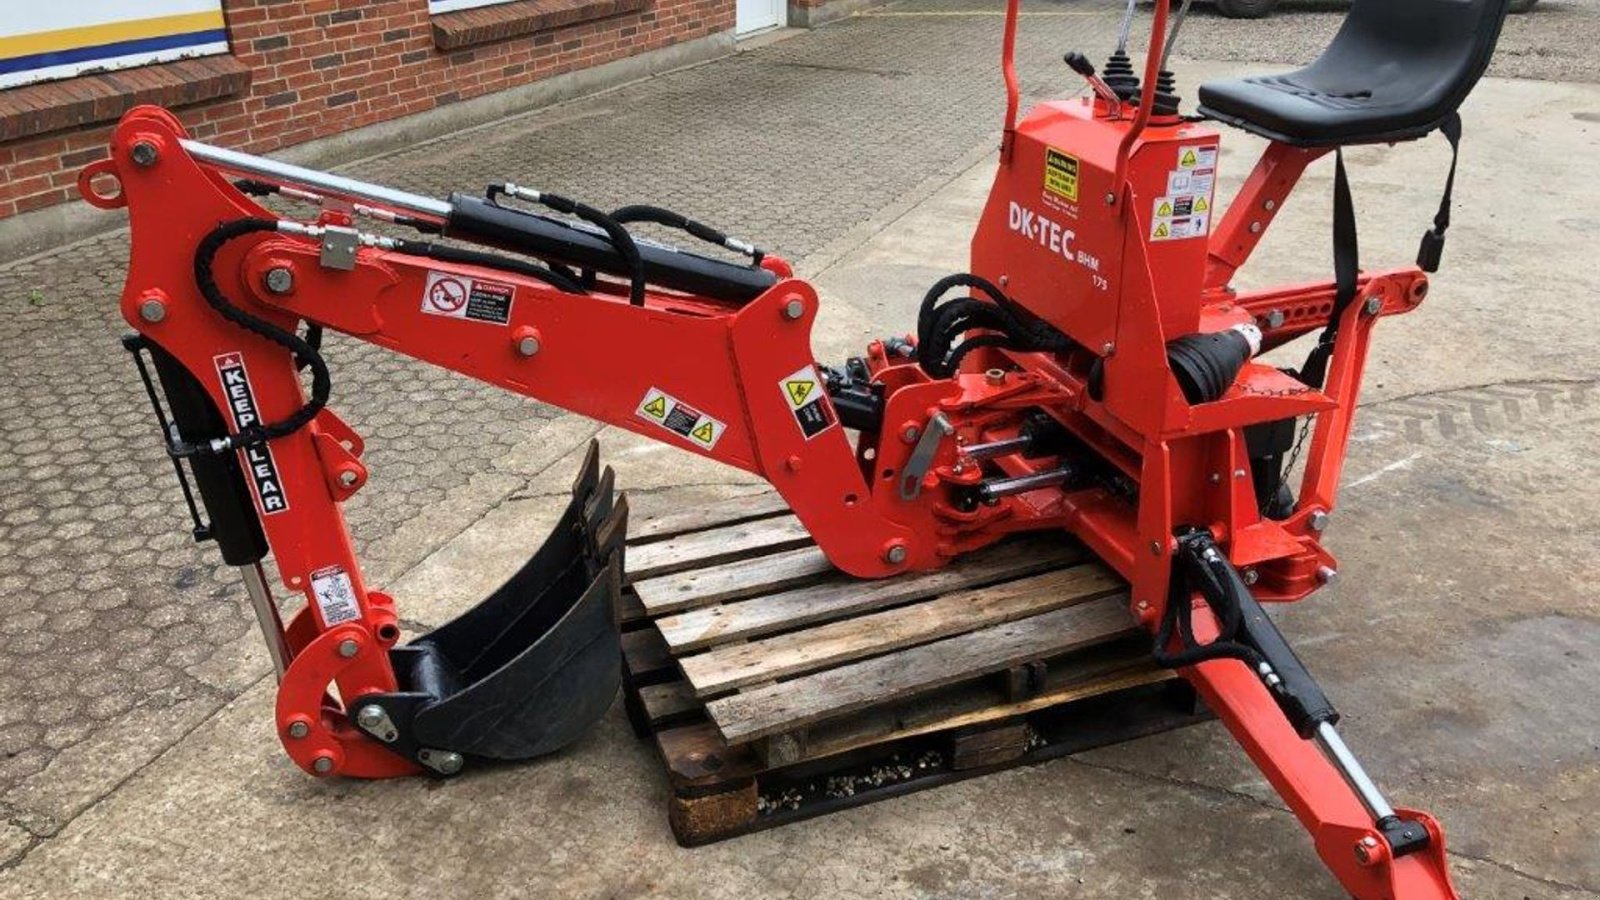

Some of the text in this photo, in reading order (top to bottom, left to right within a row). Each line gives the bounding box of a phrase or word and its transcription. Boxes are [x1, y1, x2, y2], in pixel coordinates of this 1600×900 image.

[1077, 250, 1100, 271] BHM
[1092, 274, 1108, 291] 175
[225, 369, 255, 428] KEEP
[250, 440, 283, 510] LEAR
